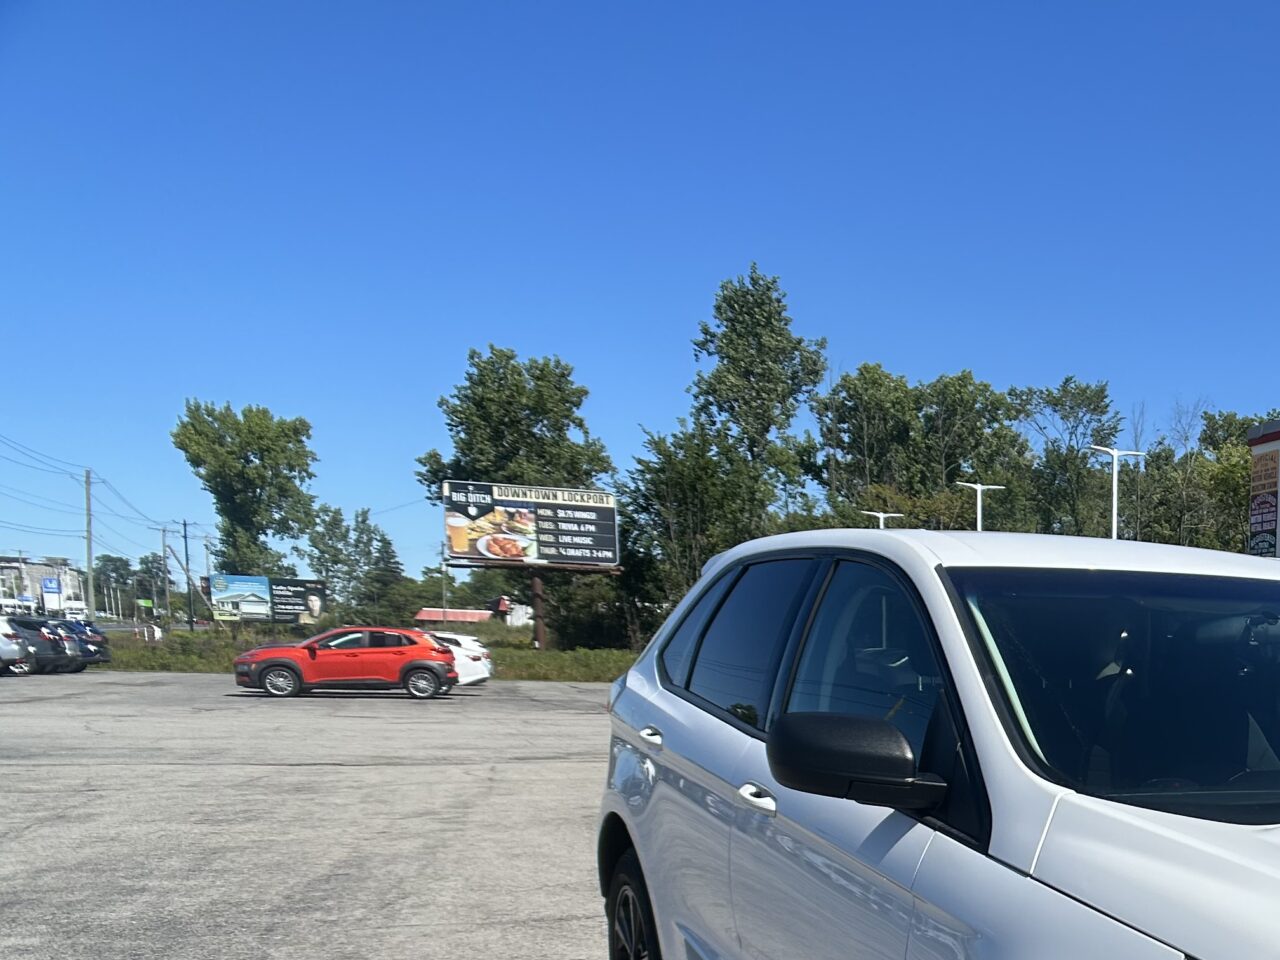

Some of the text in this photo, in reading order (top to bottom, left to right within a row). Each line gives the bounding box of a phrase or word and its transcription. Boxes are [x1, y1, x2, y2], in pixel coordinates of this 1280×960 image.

[451, 491, 466, 501] BIG
[467, 492, 491, 504] DITCH
[497, 487, 610, 505] DOWNTOWN LOCKPORT
[558, 522, 579, 531] TRIVIA
[585, 524, 596, 532] PM
[559, 535, 572, 543] LIVE
[573, 536, 593, 544] MUSIC
